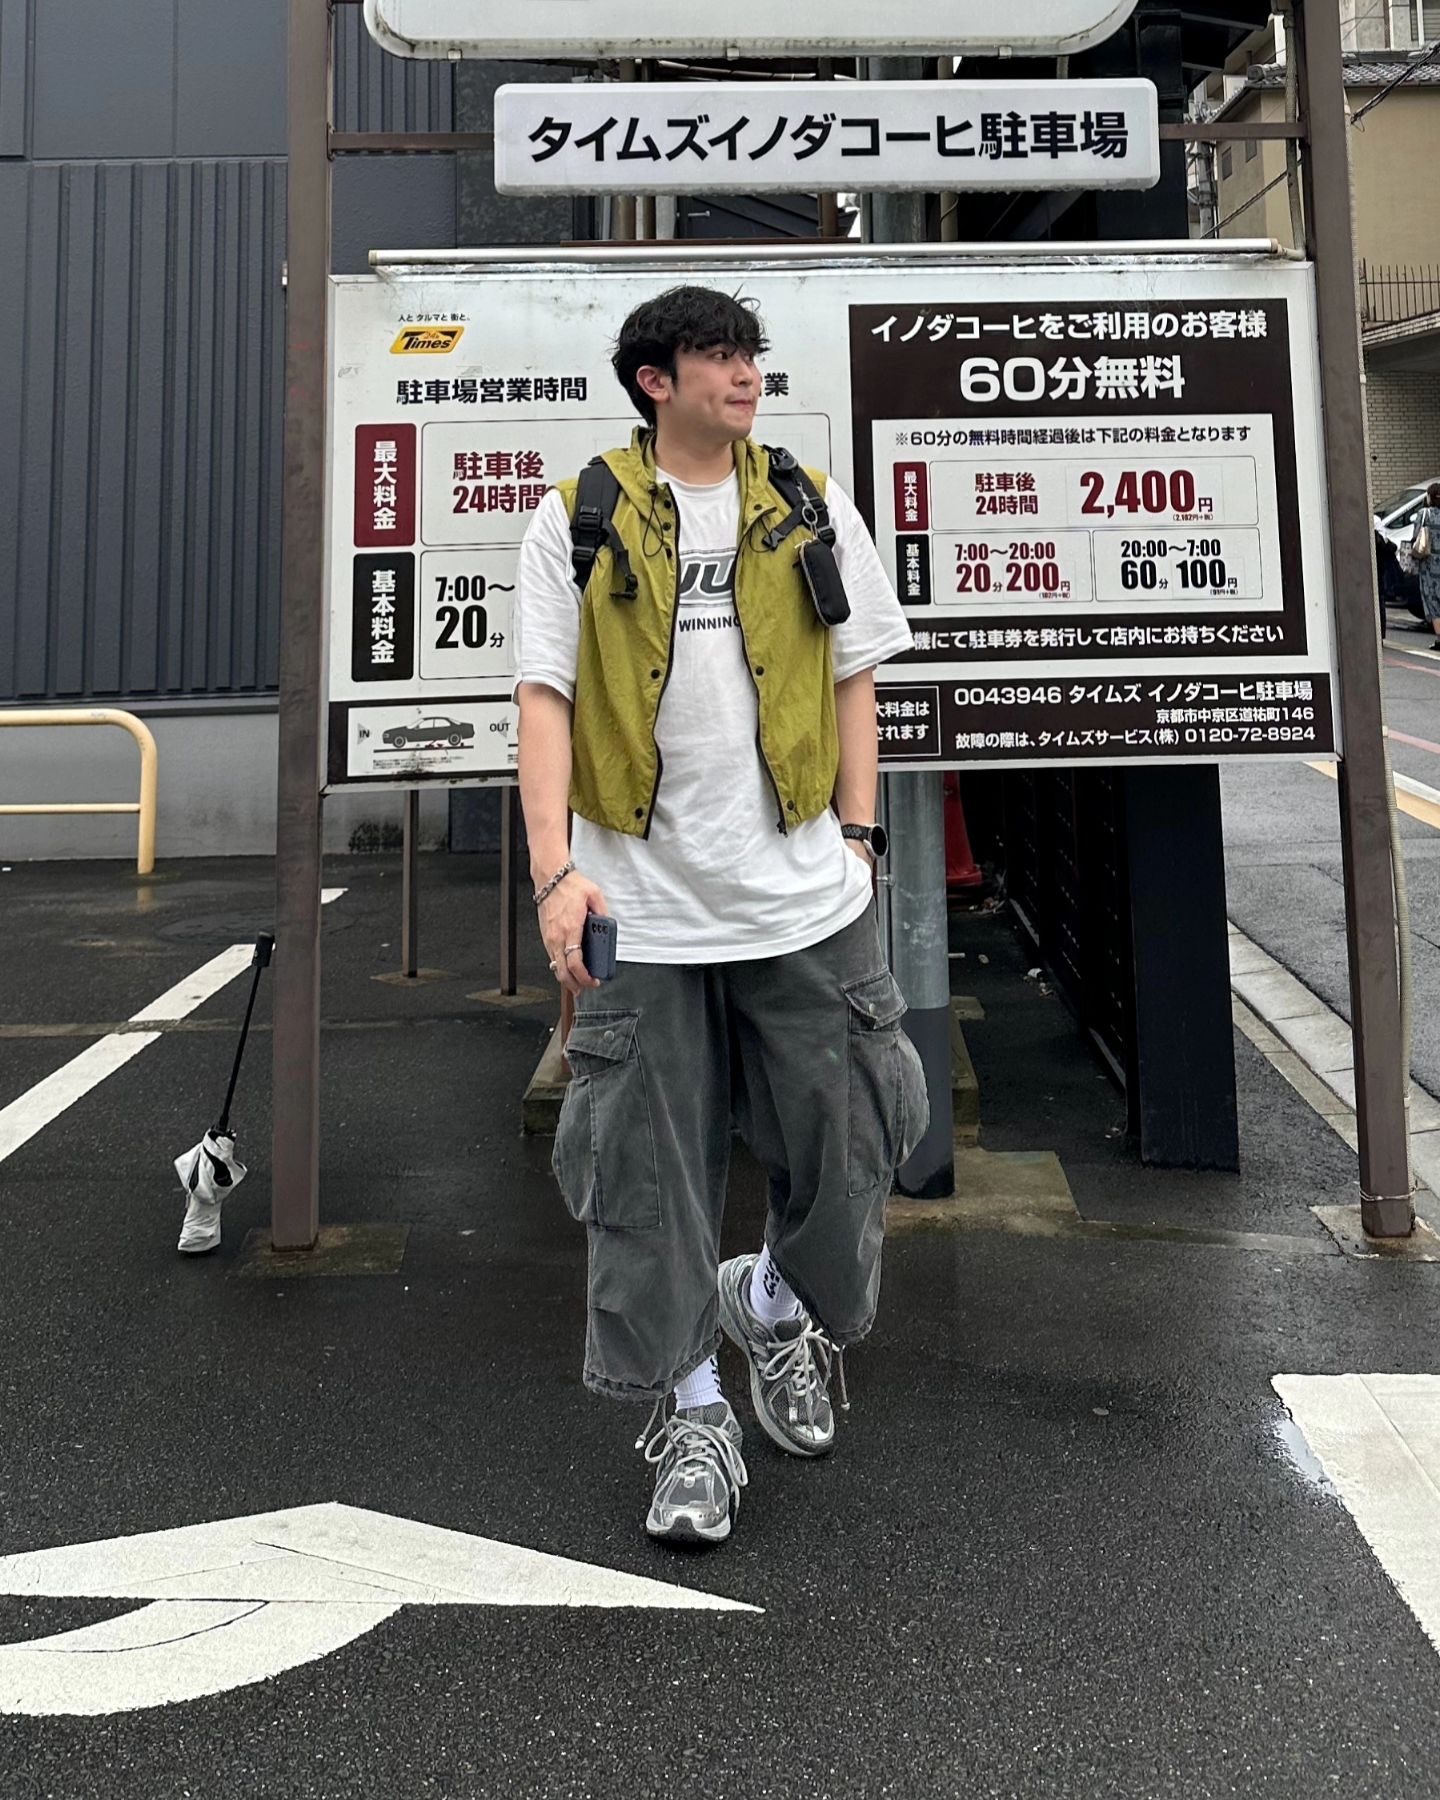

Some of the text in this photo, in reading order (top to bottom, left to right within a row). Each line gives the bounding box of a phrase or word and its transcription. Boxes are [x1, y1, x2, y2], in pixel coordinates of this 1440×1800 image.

[528, 111, 1129, 162] タイムズイノダコーヒ駐車場
[871, 311, 1268, 342] イノダコーヒをご利用のお客様
[403, 336, 451, 350] Times
[396, 372, 789, 405] 駐車場営業時間 業
[960, 355, 1186, 402] 60分無料
[895, 425, 1251, 446] ※60分の無料時間経過後は下記の料金となります
[453, 450, 545, 481] 駐車後
[373, 441, 397, 530] 最大料金
[904, 471, 919, 522] 最大料金
[975, 472, 1036, 493] 駐車後
[1080, 469, 1213, 518] 2,400円
[452, 484, 547, 514] 24時間
[975, 495, 1039, 516] 24時間
[906, 543, 921, 597] 基本料金
[371, 570, 396, 664] 基本料金
[911, 625, 1284, 650] 機にて駐車券を発行して店内にお持ちください
[954, 680, 1314, 706] 0043946 タイムズ イノダコーヒ駐車場
[359, 730, 370, 739] IN
[489, 723, 511, 732] OUT
[1185, 726, 1316, 743] 0120-72-8924
